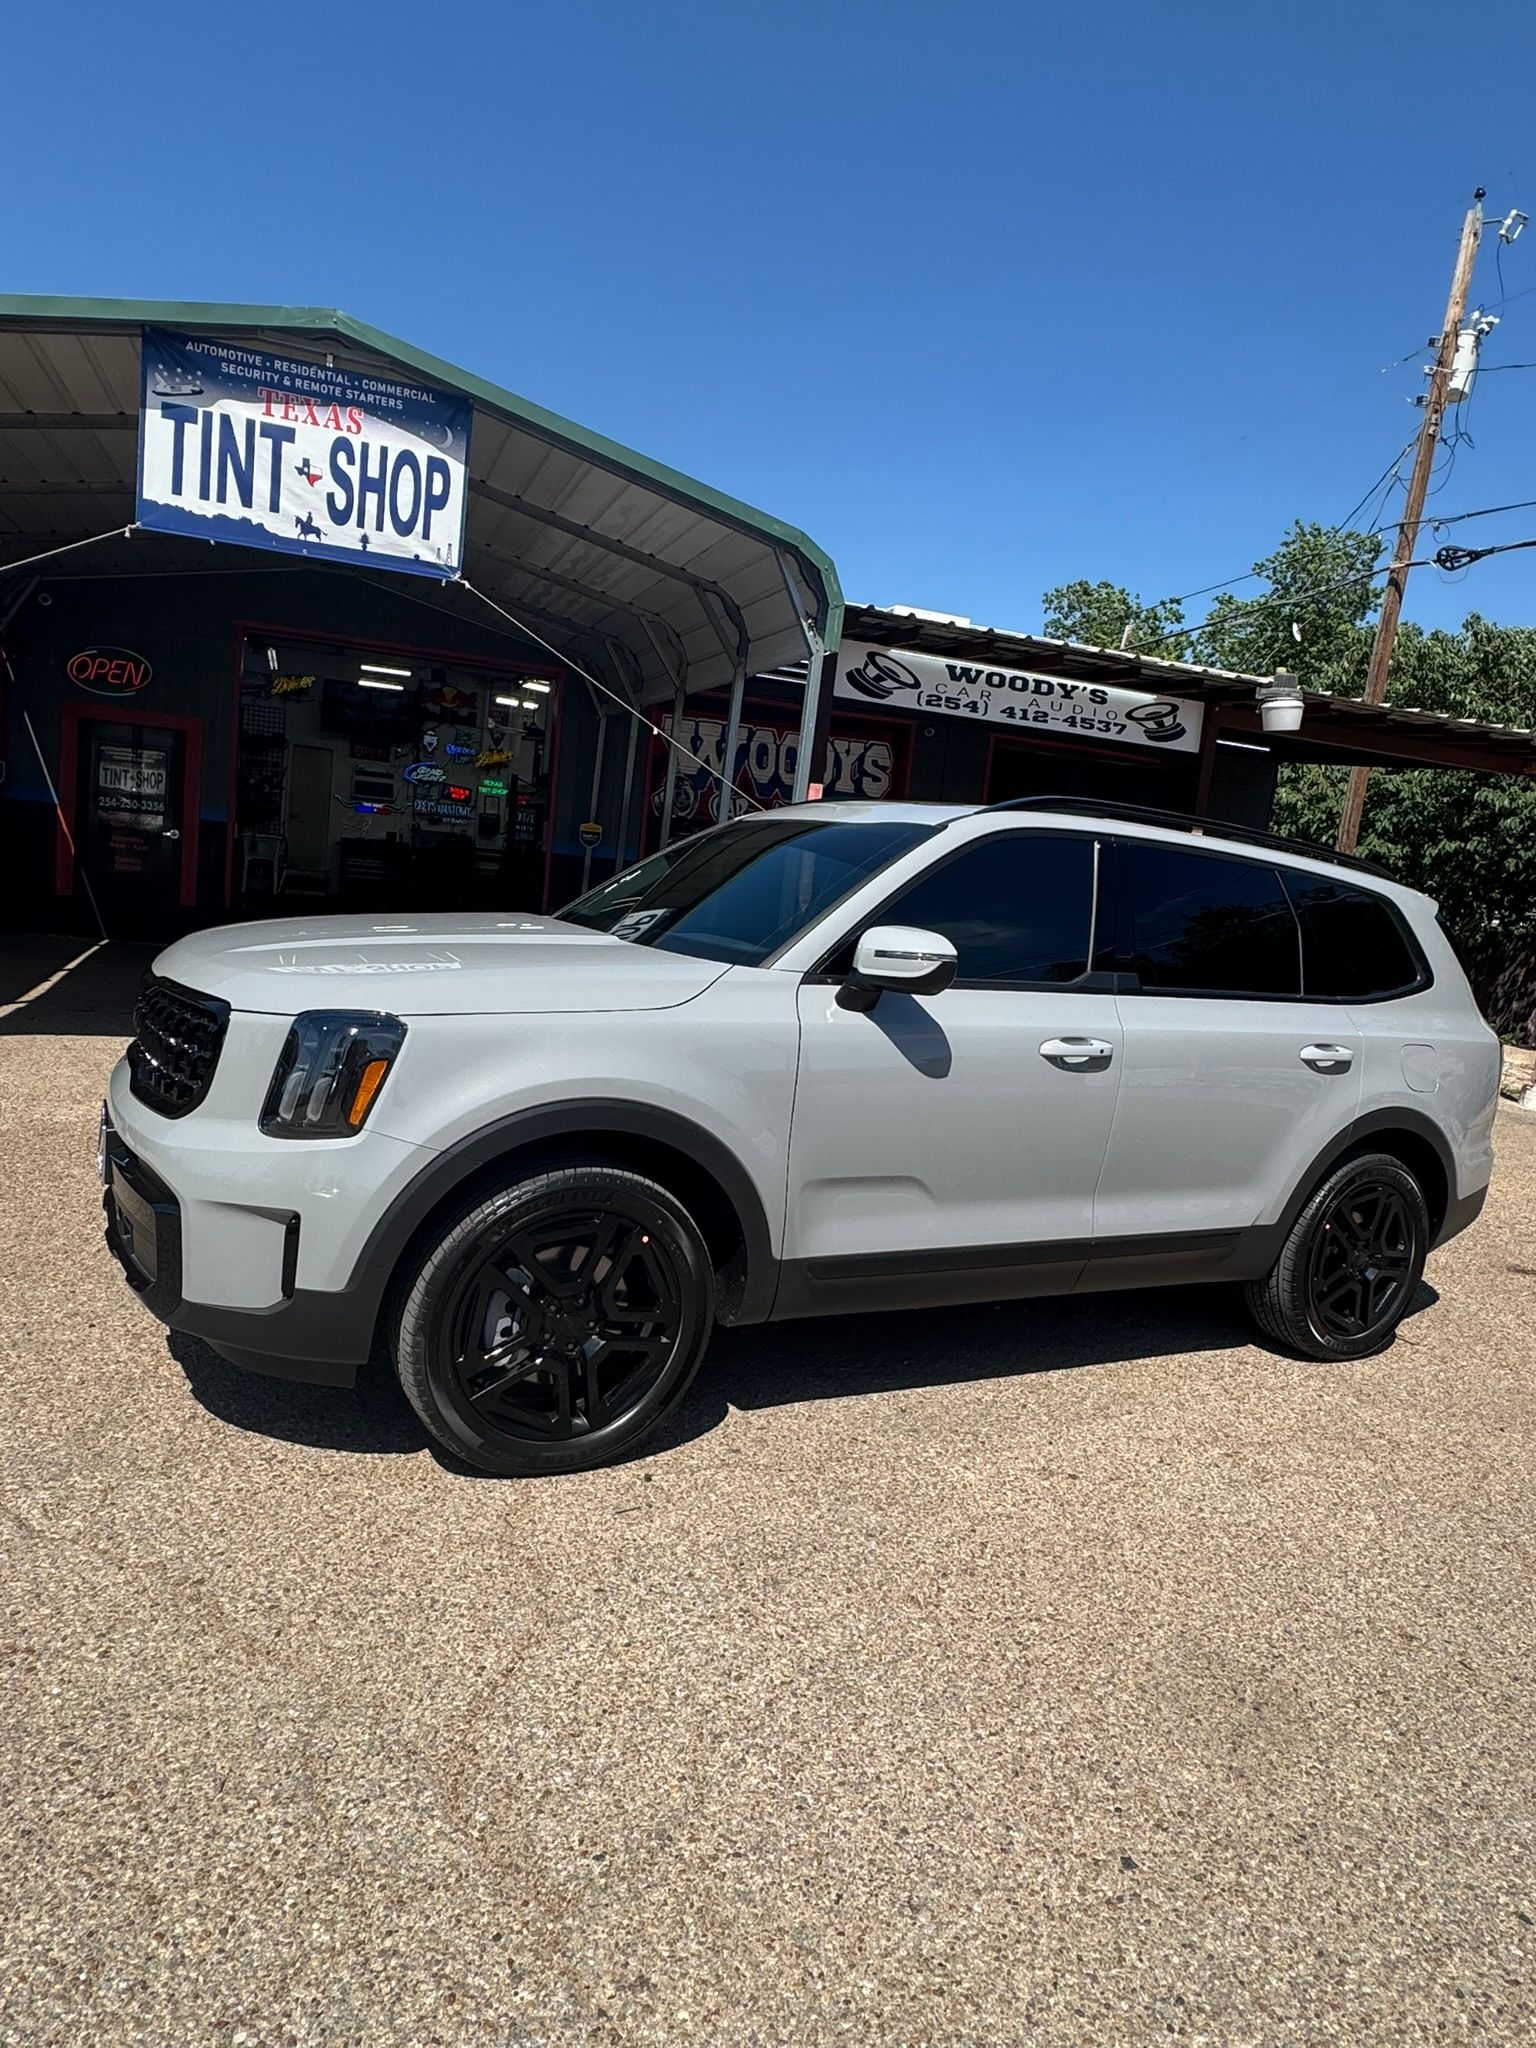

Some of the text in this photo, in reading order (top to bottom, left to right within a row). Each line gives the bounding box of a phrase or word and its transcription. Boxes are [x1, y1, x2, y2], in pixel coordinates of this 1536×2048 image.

[185, 341, 436, 403] AUTOMOTIVE RESIDENTIAL COMMERCIAL
[220, 362, 404, 409] SECURITY & REMOTE STARTERS
[257, 386, 364, 435] TEXAS
[160, 401, 451, 541] TINT SHOP
[73, 656, 145, 685] OPEN
[945, 663, 1109, 705] WOODY'S
[916, 690, 1128, 735] (254) 412-4537
[935, 682, 1118, 721] CAR AUDIO
[101, 767, 164, 790] TINT SHOP
